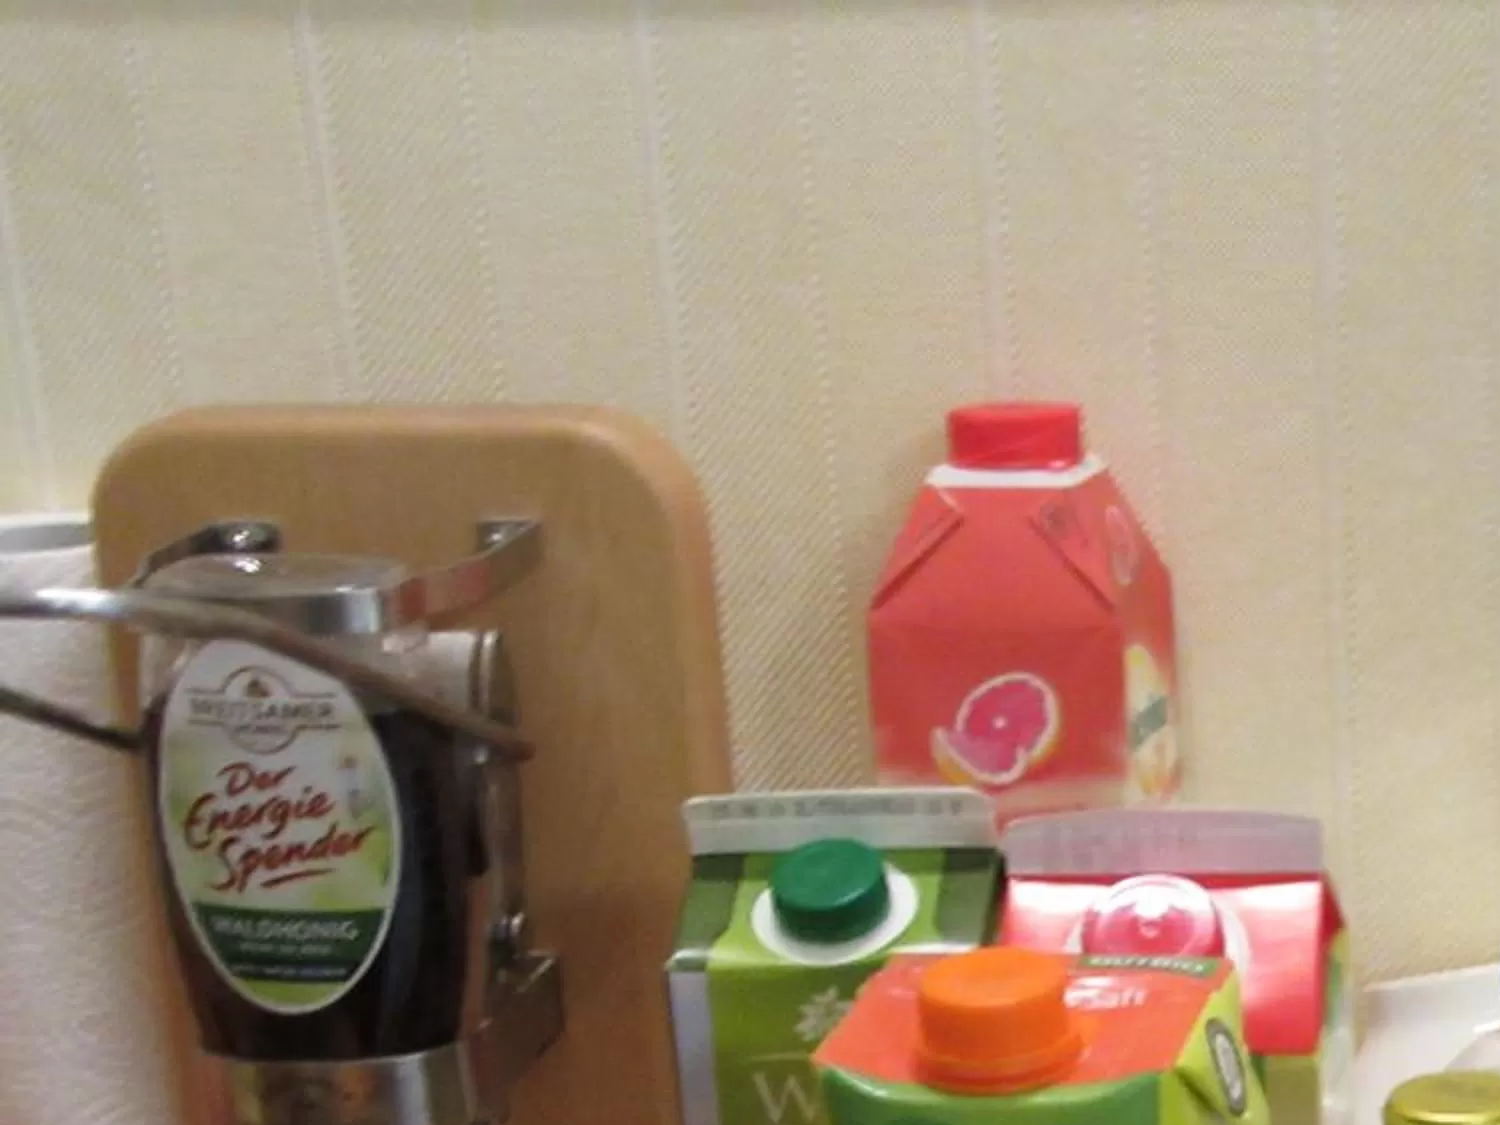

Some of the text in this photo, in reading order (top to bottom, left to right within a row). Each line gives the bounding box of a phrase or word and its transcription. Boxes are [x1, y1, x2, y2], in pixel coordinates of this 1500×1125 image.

[217, 761, 297, 794] Der
[183, 785, 335, 850] Energie
[207, 822, 376, 893] Spender
